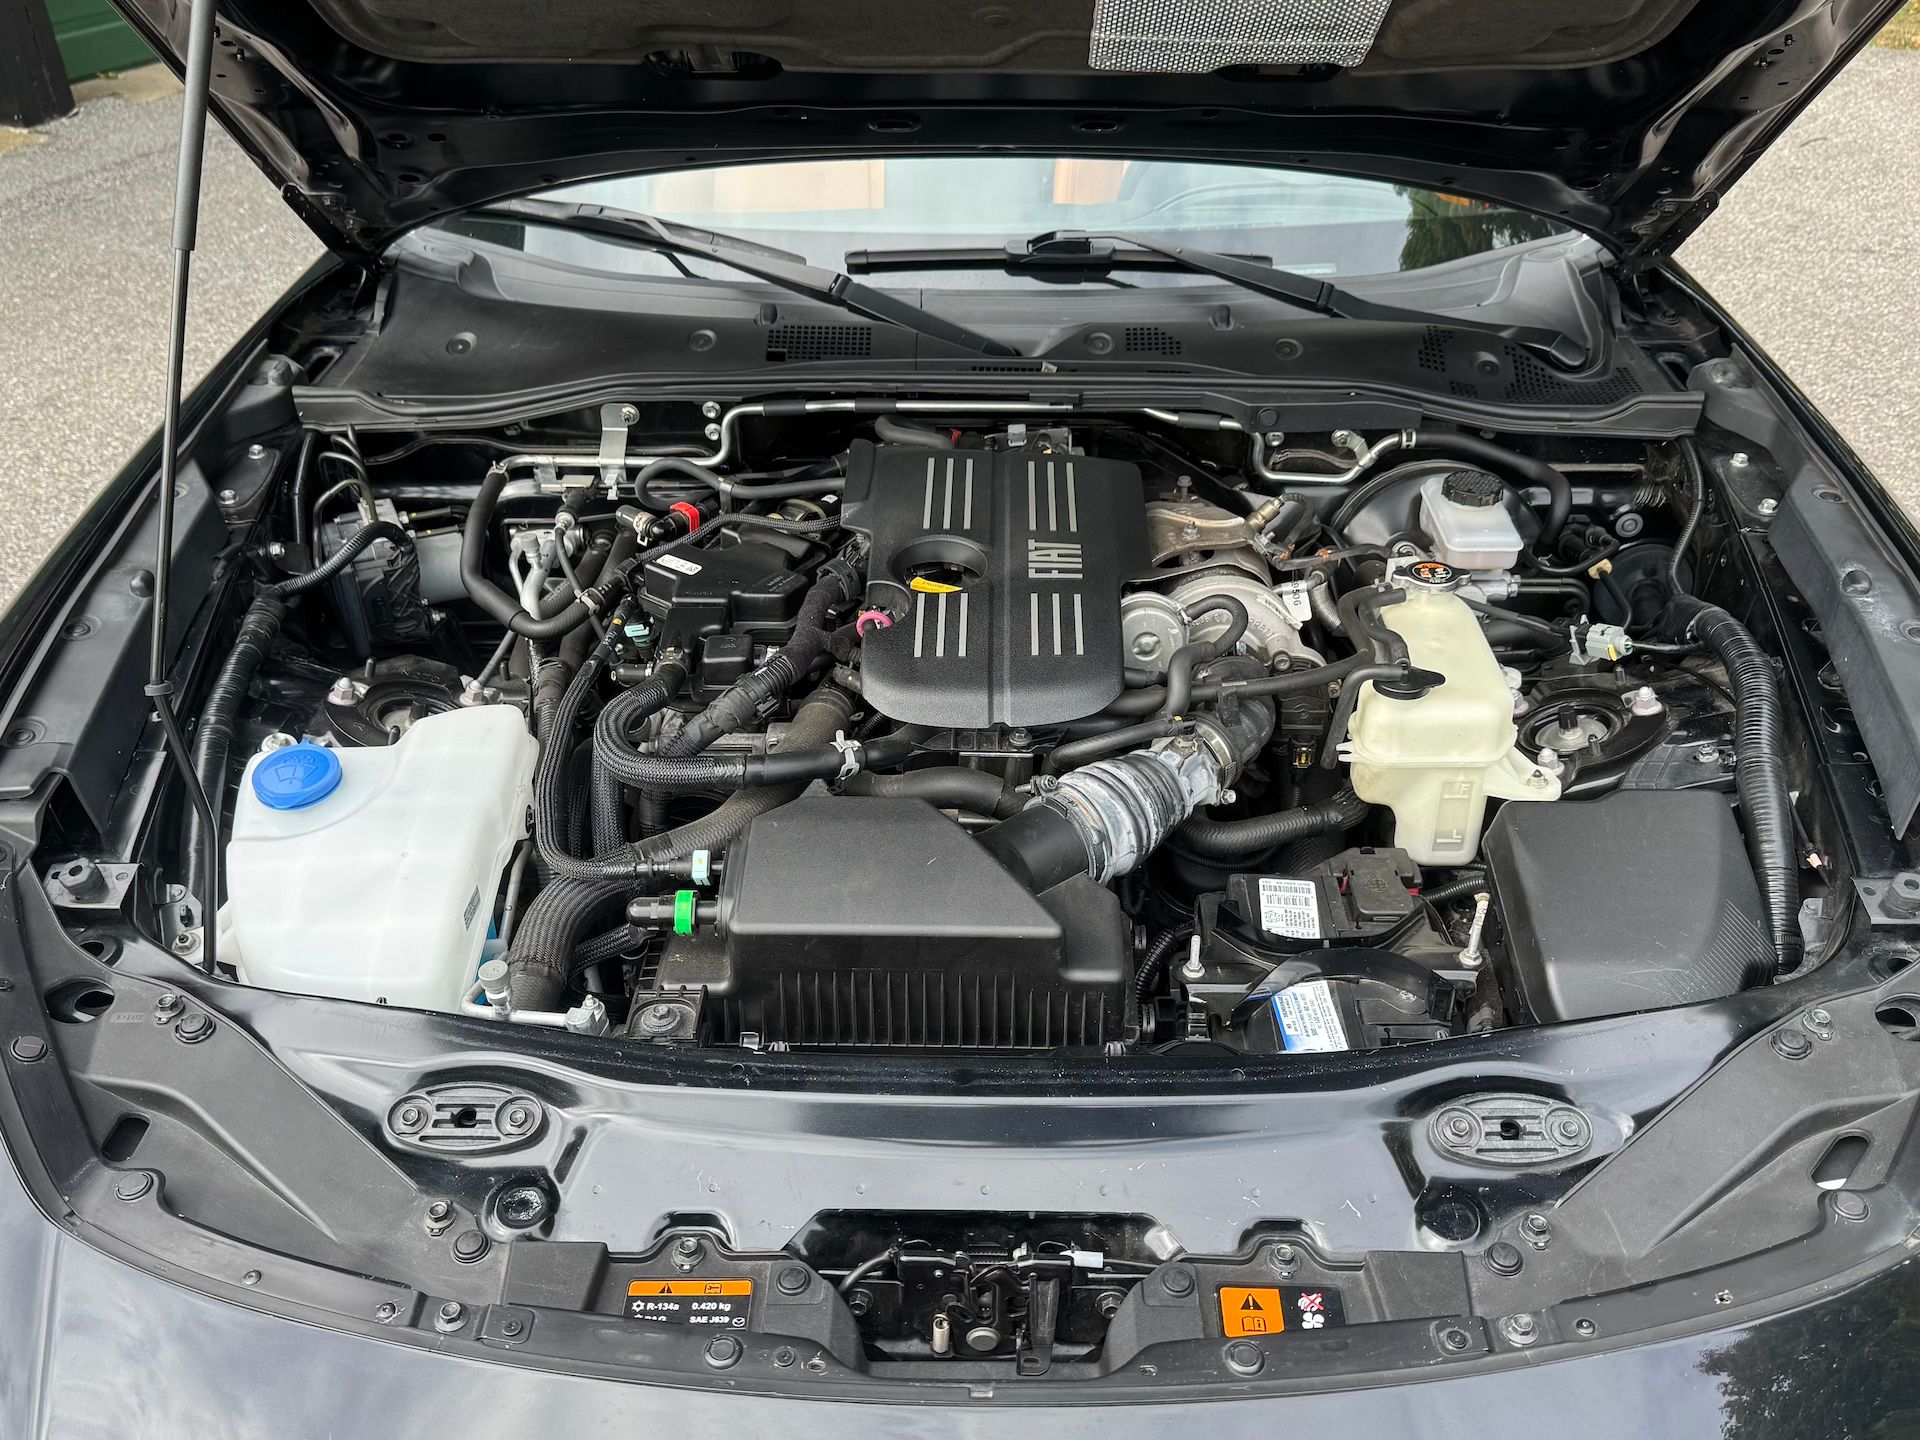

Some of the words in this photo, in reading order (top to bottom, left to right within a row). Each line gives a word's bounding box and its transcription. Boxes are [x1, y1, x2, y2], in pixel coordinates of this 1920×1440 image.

[1027, 538, 1083, 579] FIAT
[1291, 581, 1302, 607] 9506
[1460, 783, 1471, 795] F
[1452, 828, 1463, 839] L
[646, 1303, 679, 1311] R-134a
[692, 1302, 717, 1311] 0.420
[719, 1302, 731, 1311] kg
[689, 1316, 708, 1324] SAE
